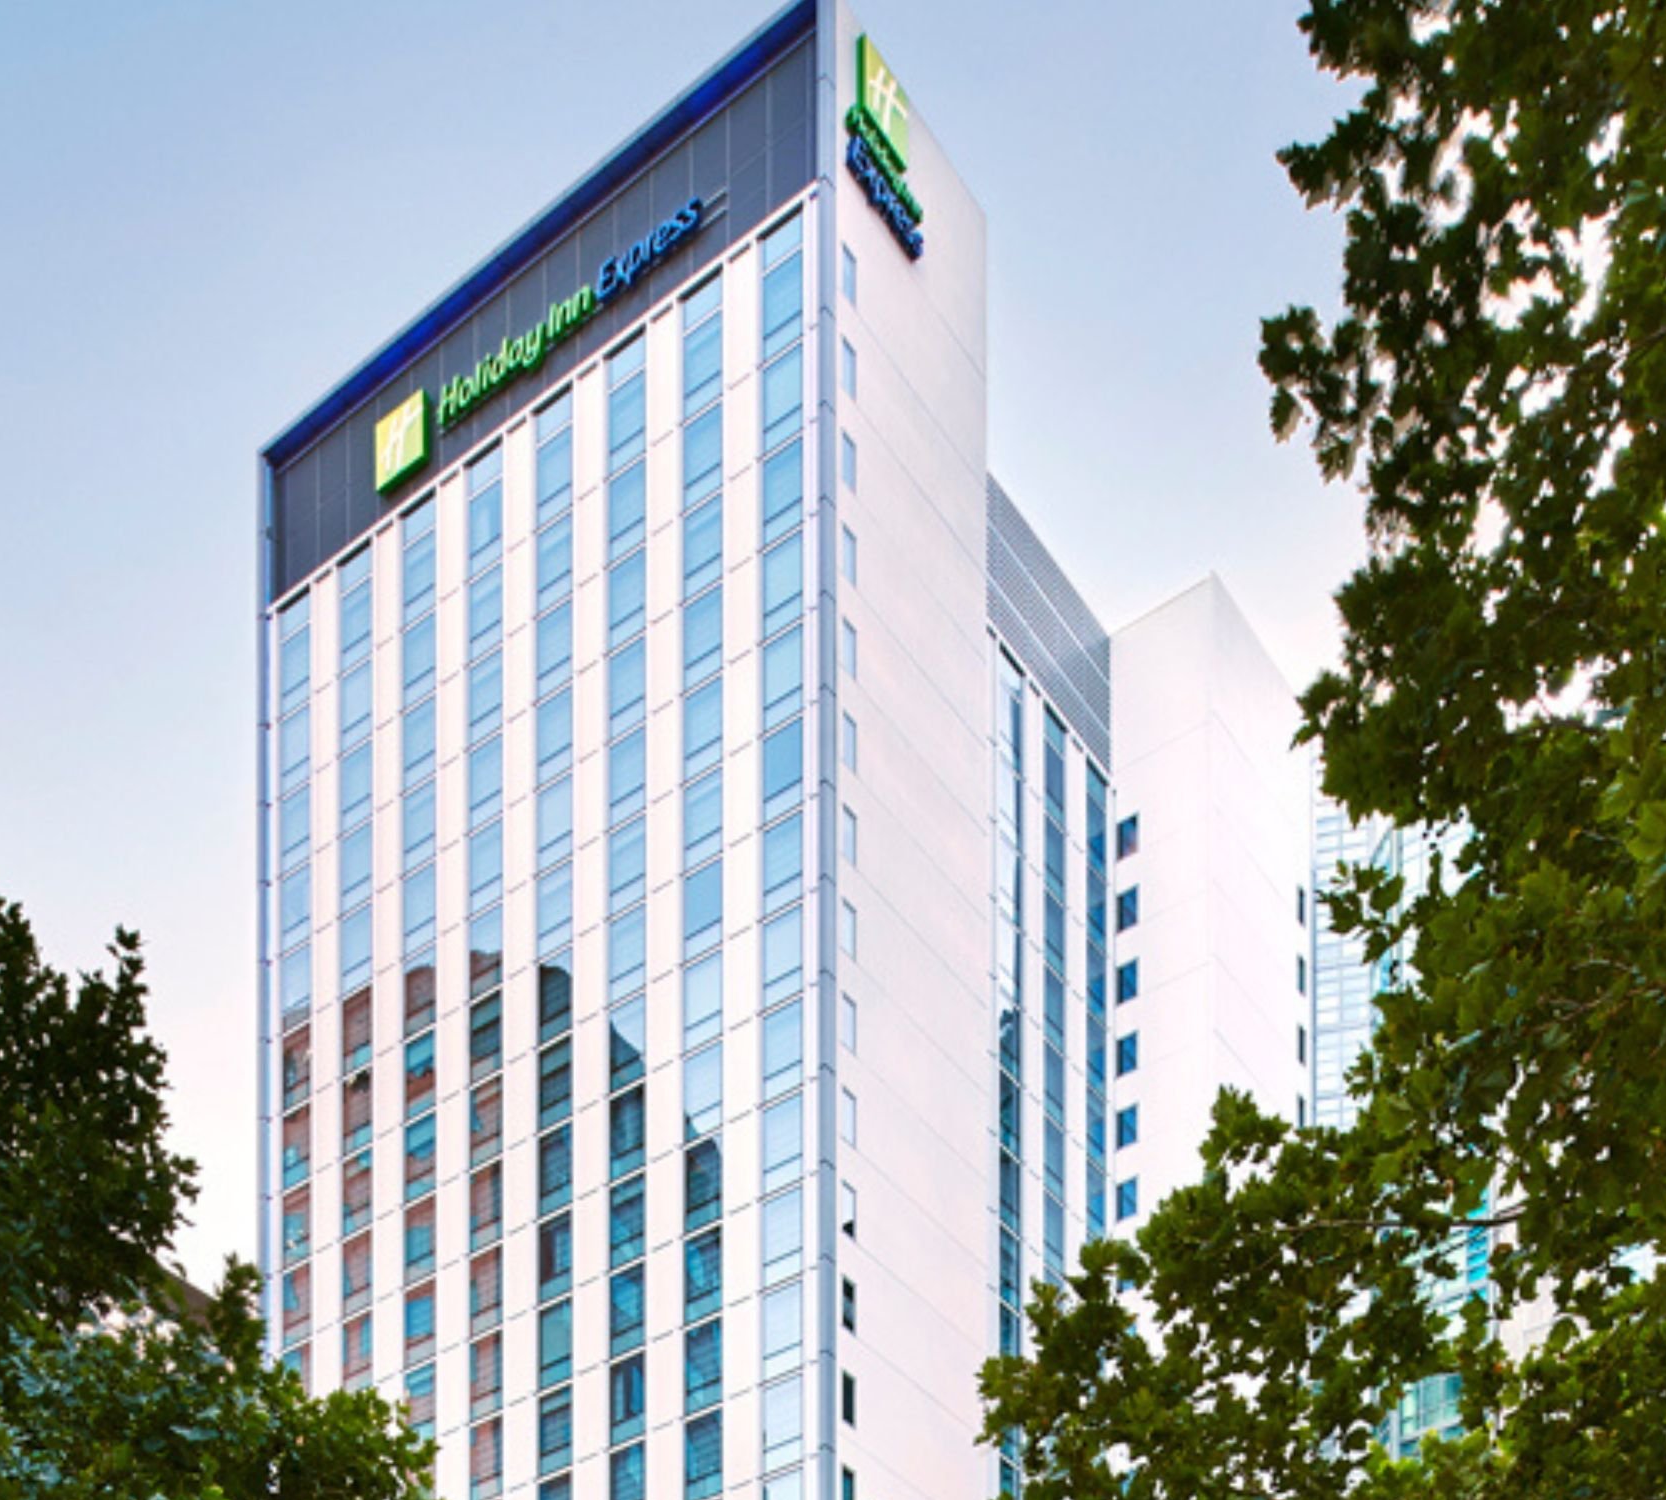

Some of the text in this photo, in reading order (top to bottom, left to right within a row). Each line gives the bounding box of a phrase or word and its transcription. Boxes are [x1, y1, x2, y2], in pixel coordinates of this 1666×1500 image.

[436, 196, 704, 428] Holiday Inn Express
